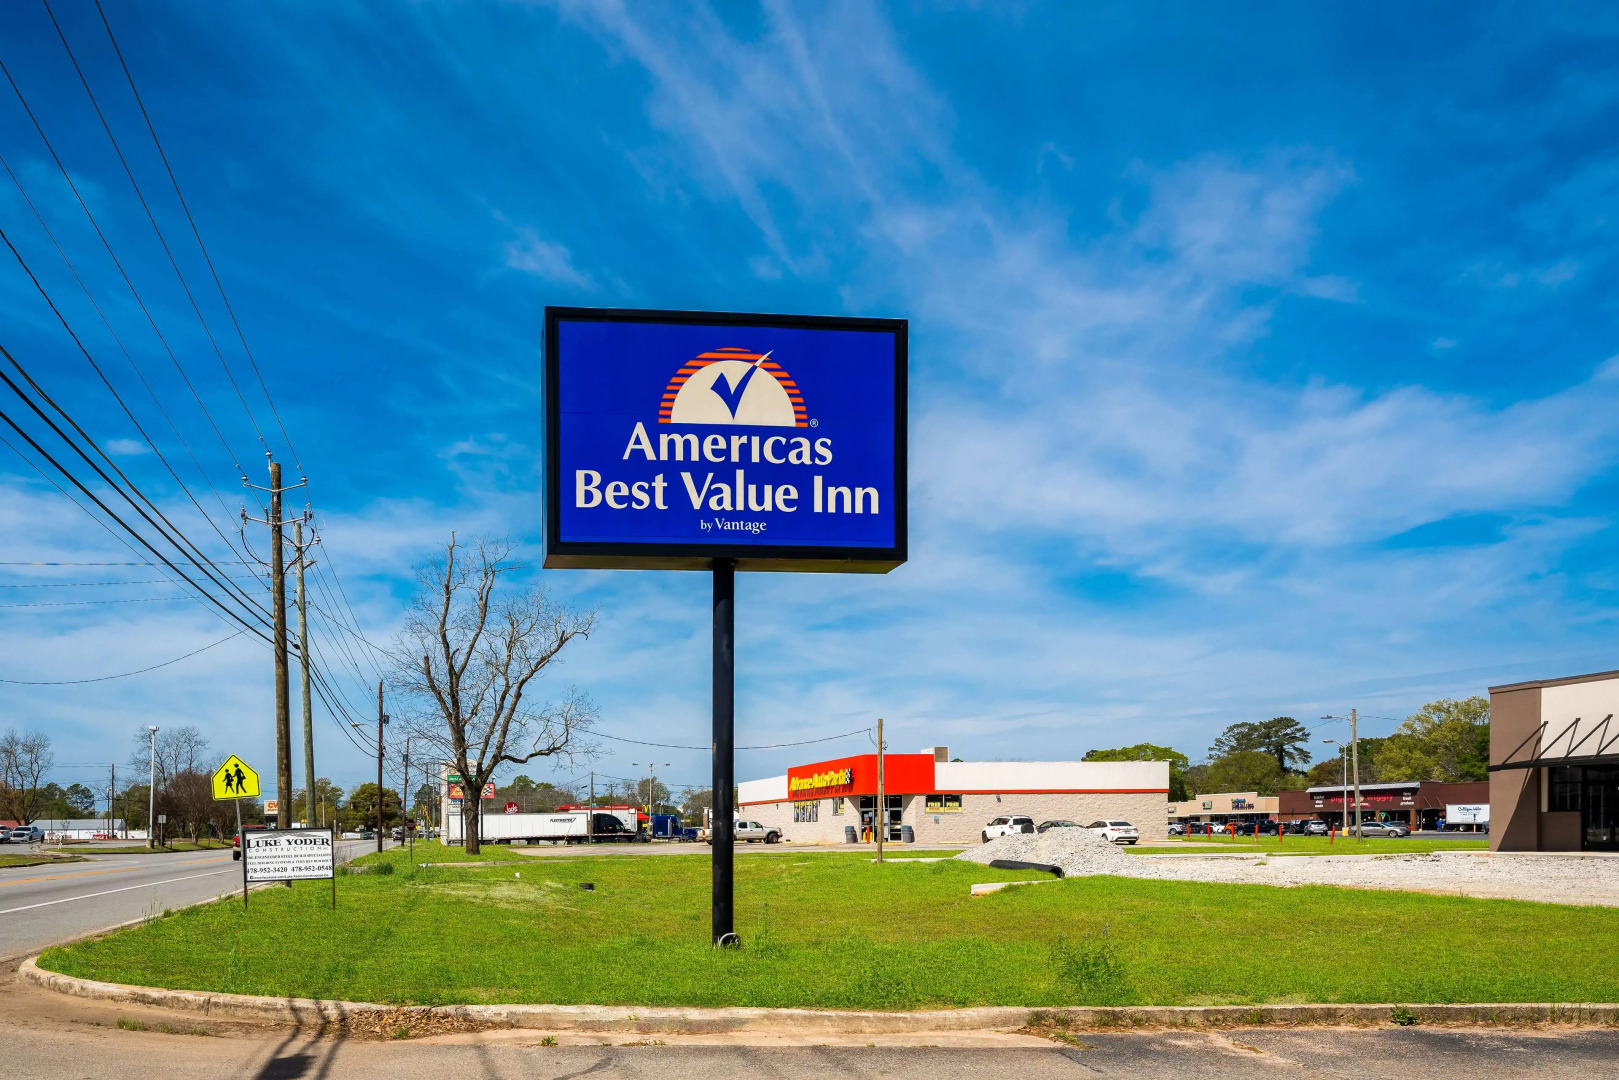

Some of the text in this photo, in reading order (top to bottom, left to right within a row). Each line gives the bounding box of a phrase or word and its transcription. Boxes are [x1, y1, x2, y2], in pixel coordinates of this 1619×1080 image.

[622, 421, 833, 466] Americas
[575, 469, 879, 515] Best Value Inn
[700, 517, 767, 534] by Vantage
[246, 837, 331, 849] LUKE YODER
